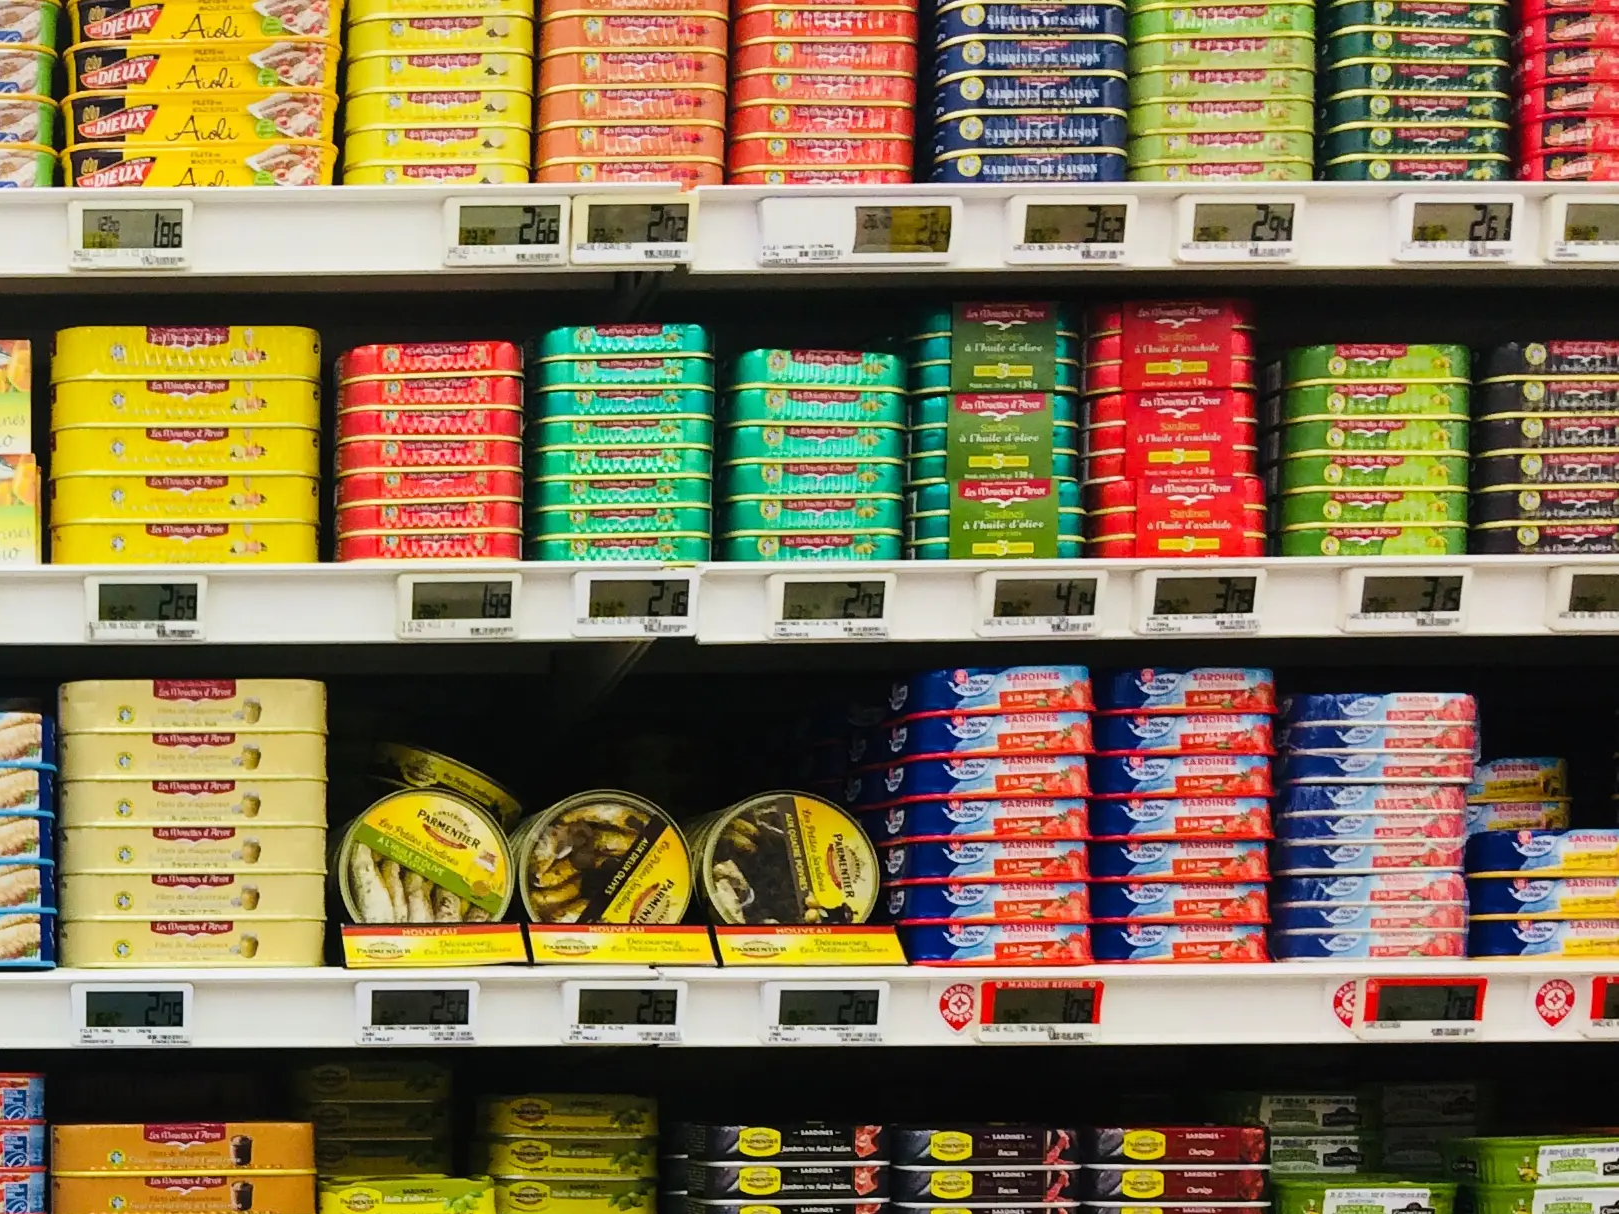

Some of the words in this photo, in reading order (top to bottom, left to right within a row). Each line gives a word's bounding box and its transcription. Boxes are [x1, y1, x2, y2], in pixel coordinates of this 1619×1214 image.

[104, 62, 150, 86] DIEUX
[100, 114, 150, 135] DIEUX
[1058, 164, 1098, 175] SAISON
[417, 809, 481, 849] PARMENTIER
[833, 834, 854, 898] PARMENTIER
[402, 928, 458, 936] NOUVEAU
[742, 1137, 779, 1146] PARMENTIER
